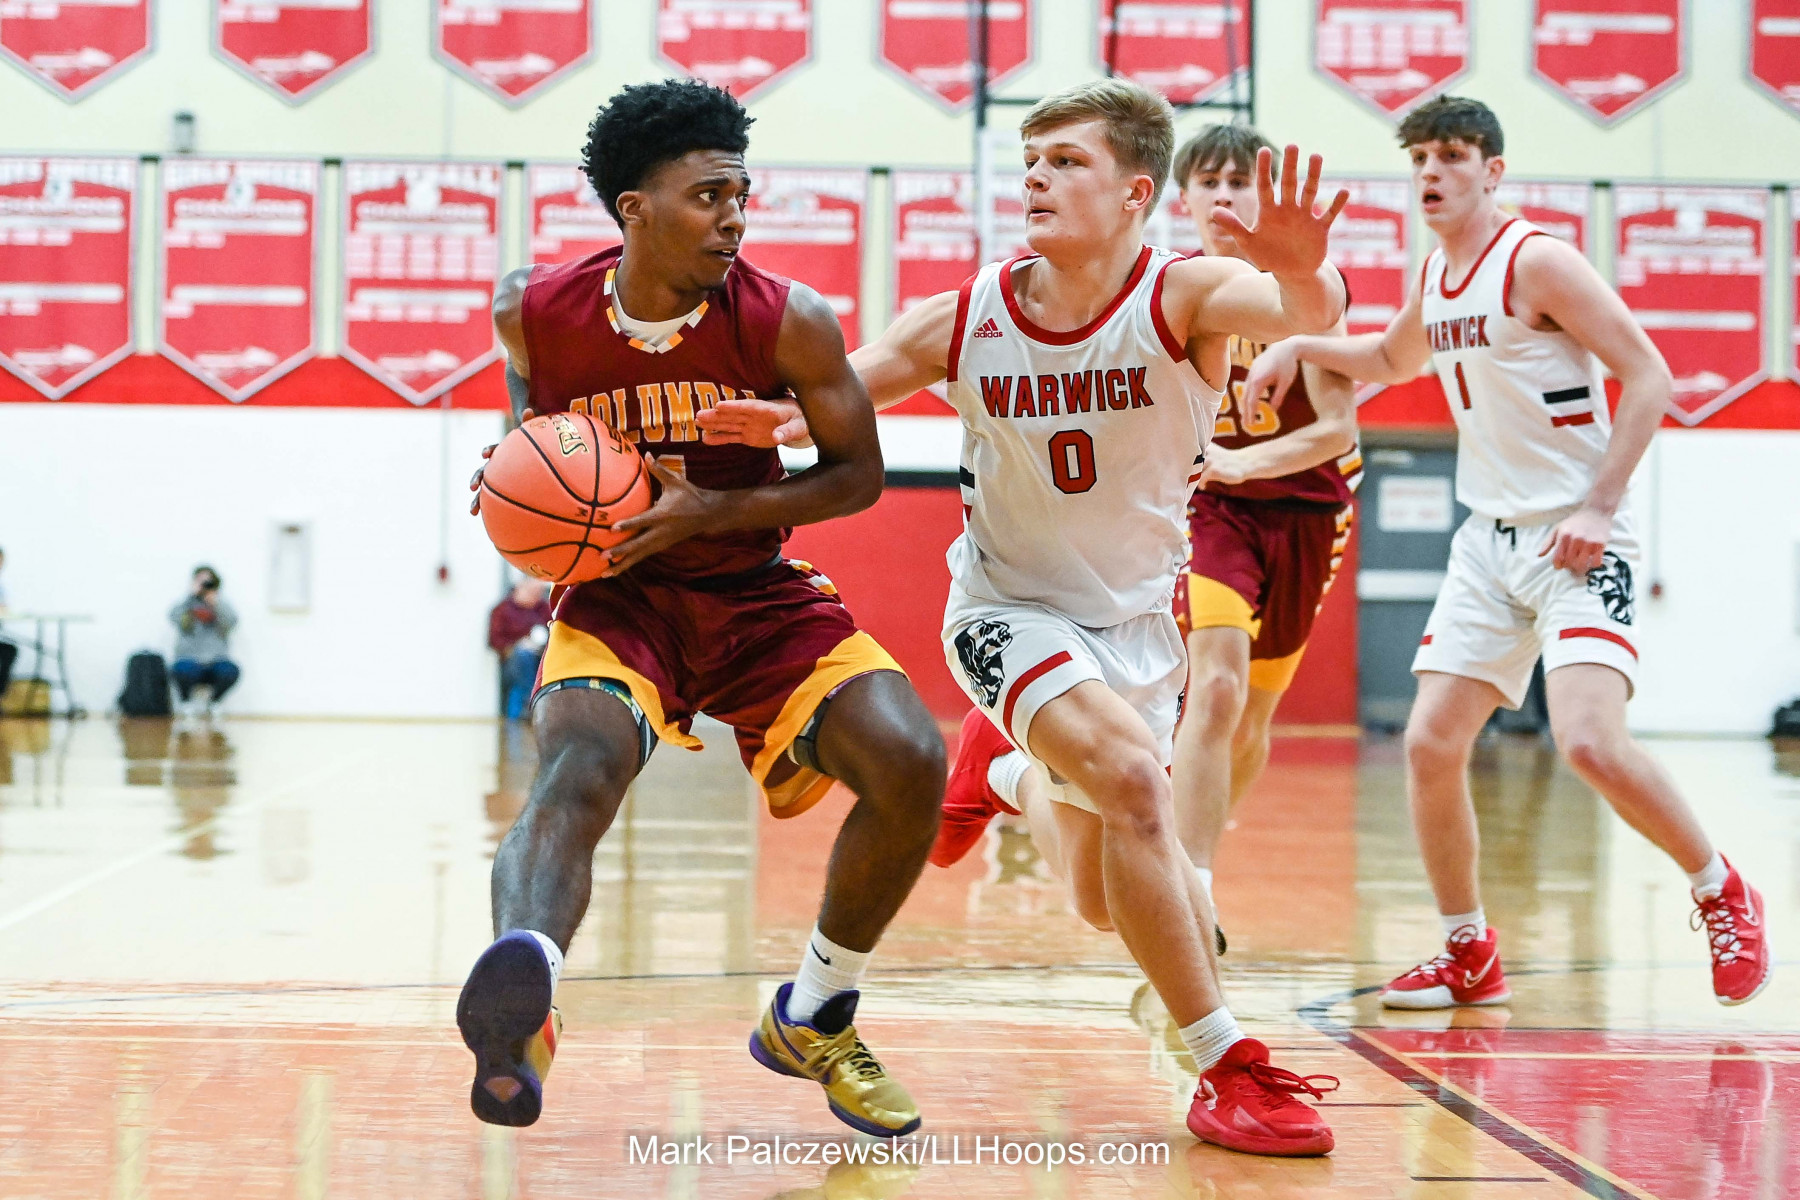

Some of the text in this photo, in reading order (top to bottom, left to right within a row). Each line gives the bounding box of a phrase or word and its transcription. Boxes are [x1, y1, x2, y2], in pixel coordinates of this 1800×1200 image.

[974, 330, 1003, 338] adidas
[980, 366, 1155, 418] WARWICK
[1455, 362, 1472, 410] 1
[1047, 429, 1097, 494] 0
